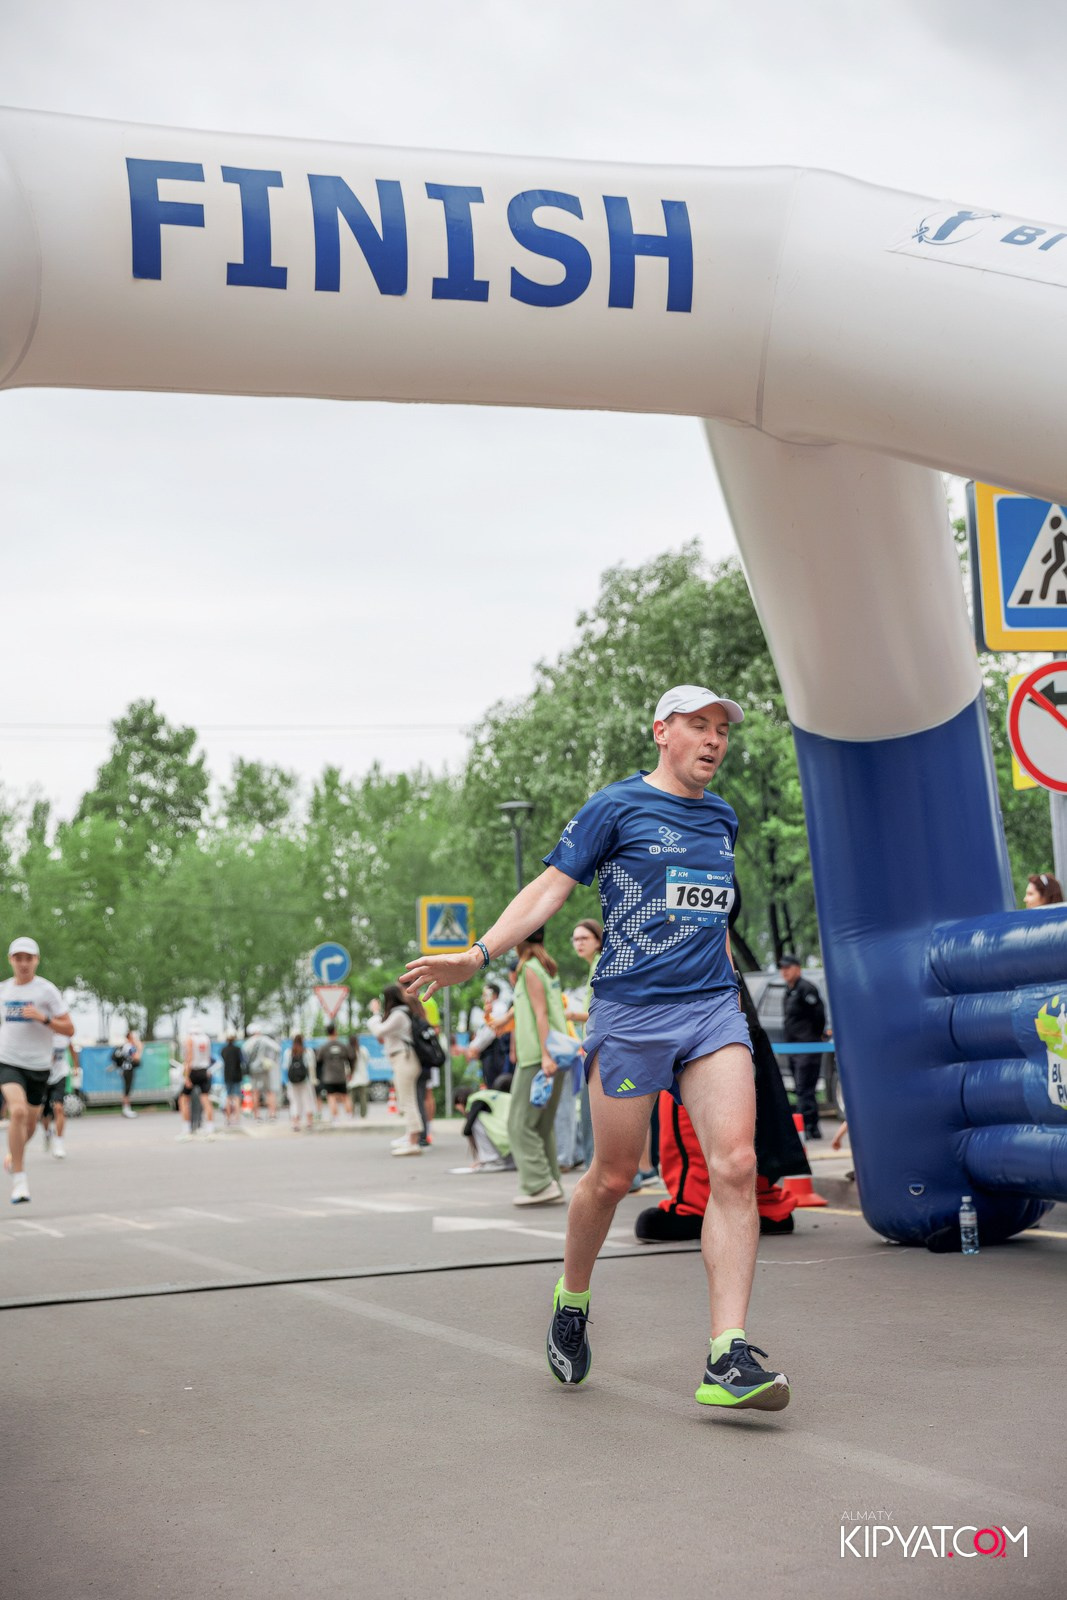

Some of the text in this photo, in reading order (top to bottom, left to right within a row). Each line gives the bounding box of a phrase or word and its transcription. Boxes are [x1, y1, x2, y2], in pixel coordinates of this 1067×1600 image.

[125, 157, 694, 313] FINISH
[670, 869, 677, 877] 5
[676, 885, 728, 910] 1694
[1052, 1063, 1062, 1083] BI
